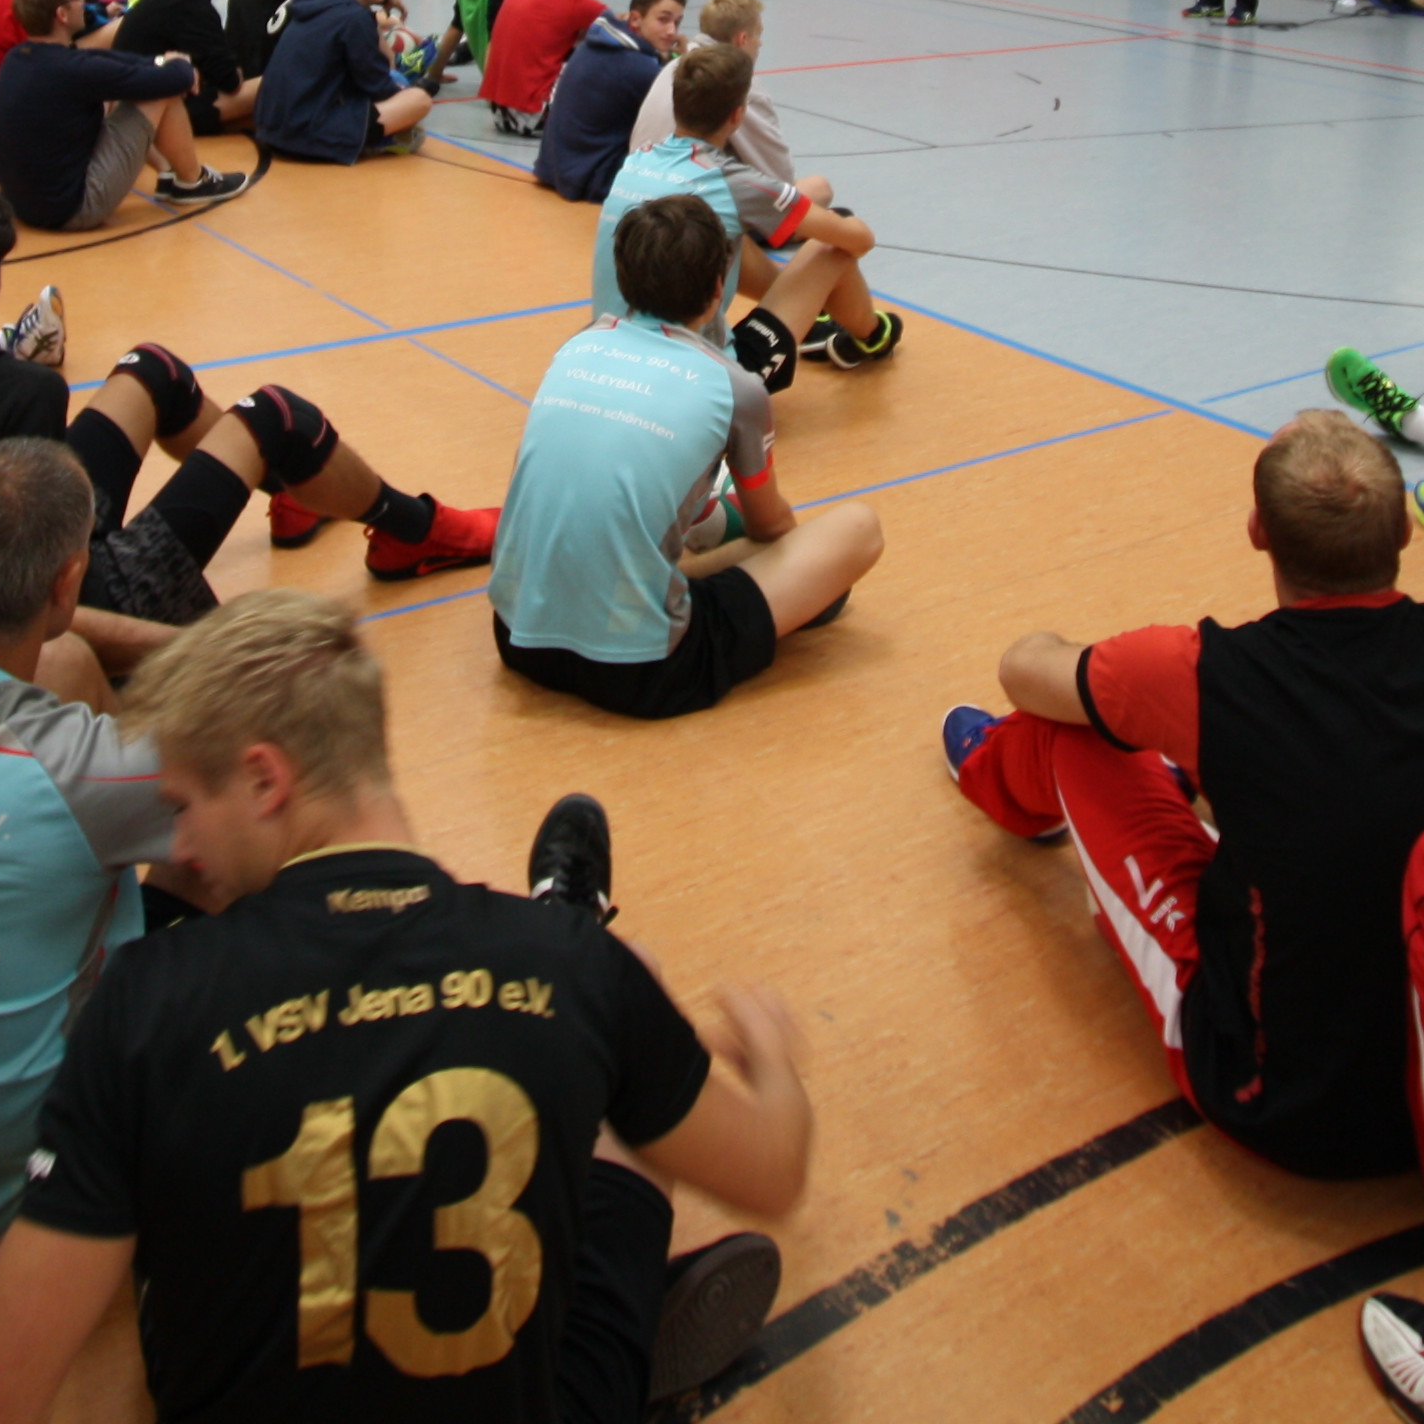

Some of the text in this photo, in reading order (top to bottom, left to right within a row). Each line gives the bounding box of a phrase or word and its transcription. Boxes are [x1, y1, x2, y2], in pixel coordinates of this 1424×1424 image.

[603, 348, 643, 364] Jena
[566, 367, 654, 397] VOLLEYBALL
[579, 402, 601, 416] am
[603, 408, 675, 441] schönsten
[244, 989, 331, 1053] VSV
[337, 982, 436, 1027] Jena
[440, 968, 494, 1010] 90
[240, 1066, 544, 1379] 13
